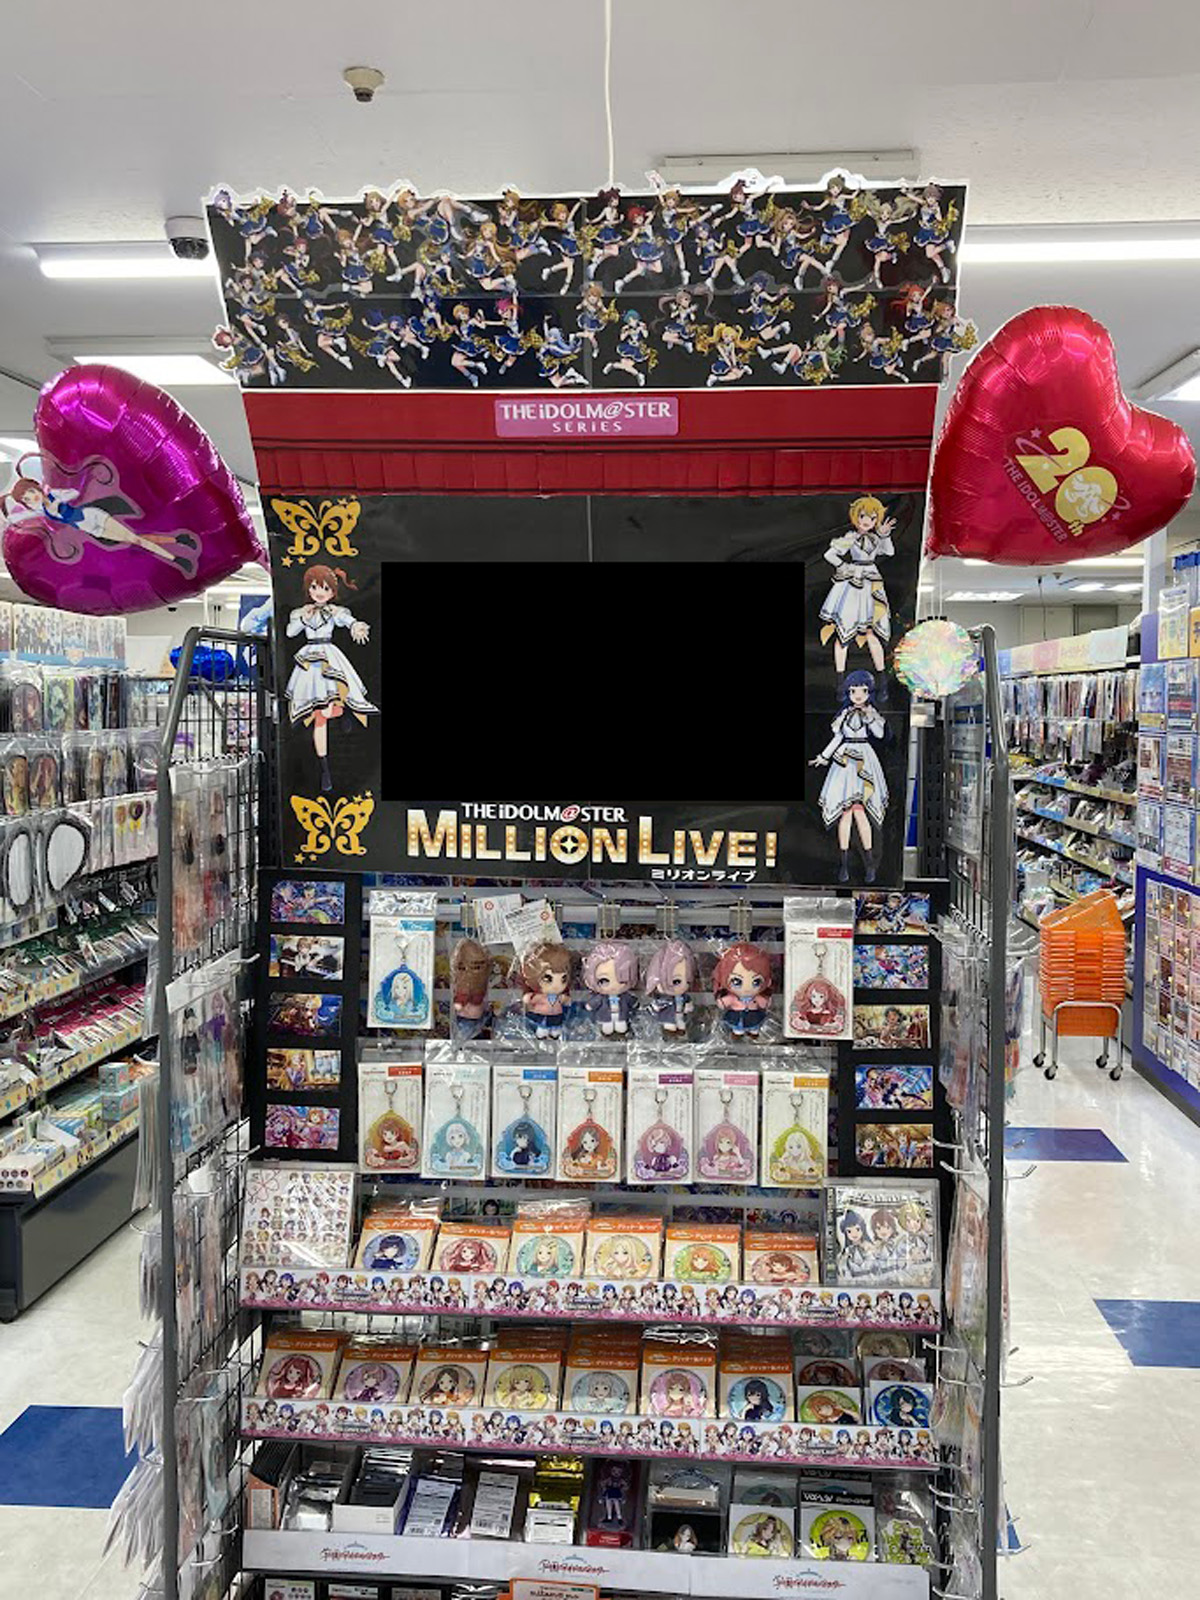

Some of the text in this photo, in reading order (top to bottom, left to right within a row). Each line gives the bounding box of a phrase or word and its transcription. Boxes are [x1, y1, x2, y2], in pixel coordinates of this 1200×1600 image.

[1003, 455, 1024, 483] THE
[407, 809, 778, 867] MILLION LIVE!
[651, 869, 757, 882] ミリオンライブ
